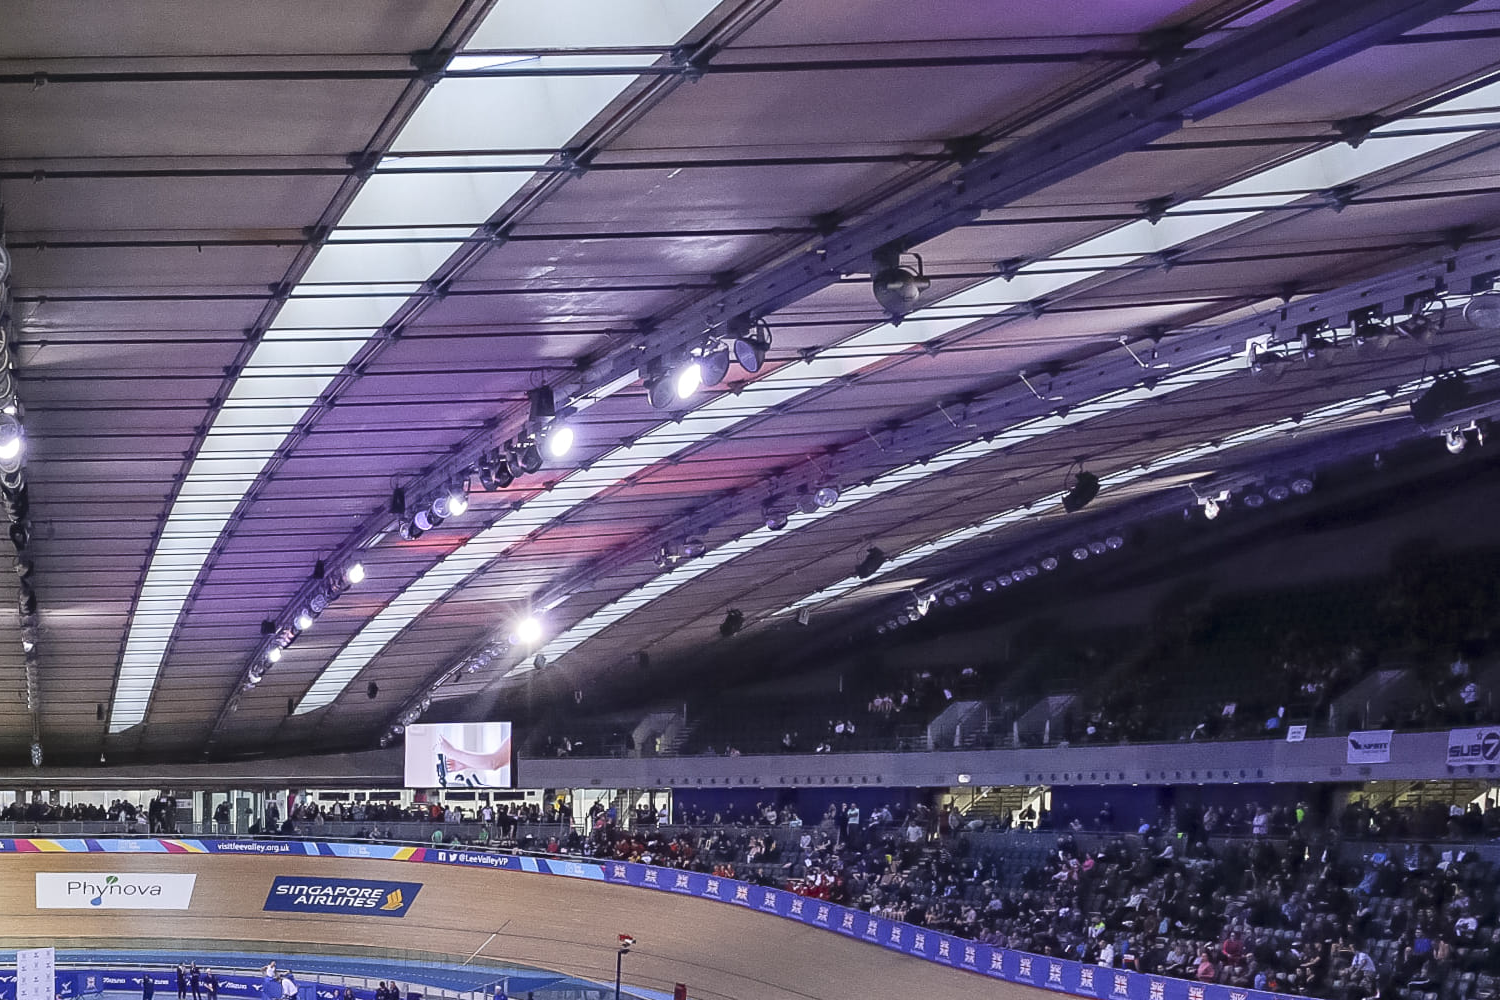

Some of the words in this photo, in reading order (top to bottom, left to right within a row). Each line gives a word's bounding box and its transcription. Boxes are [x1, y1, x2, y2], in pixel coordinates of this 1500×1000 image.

[458, 853, 509, 866] @LeeValleyVP
[67, 881, 162, 897] Phynova
[275, 884, 385, 898] SINGAPORE
[294, 895, 379, 908] AIRLINES
